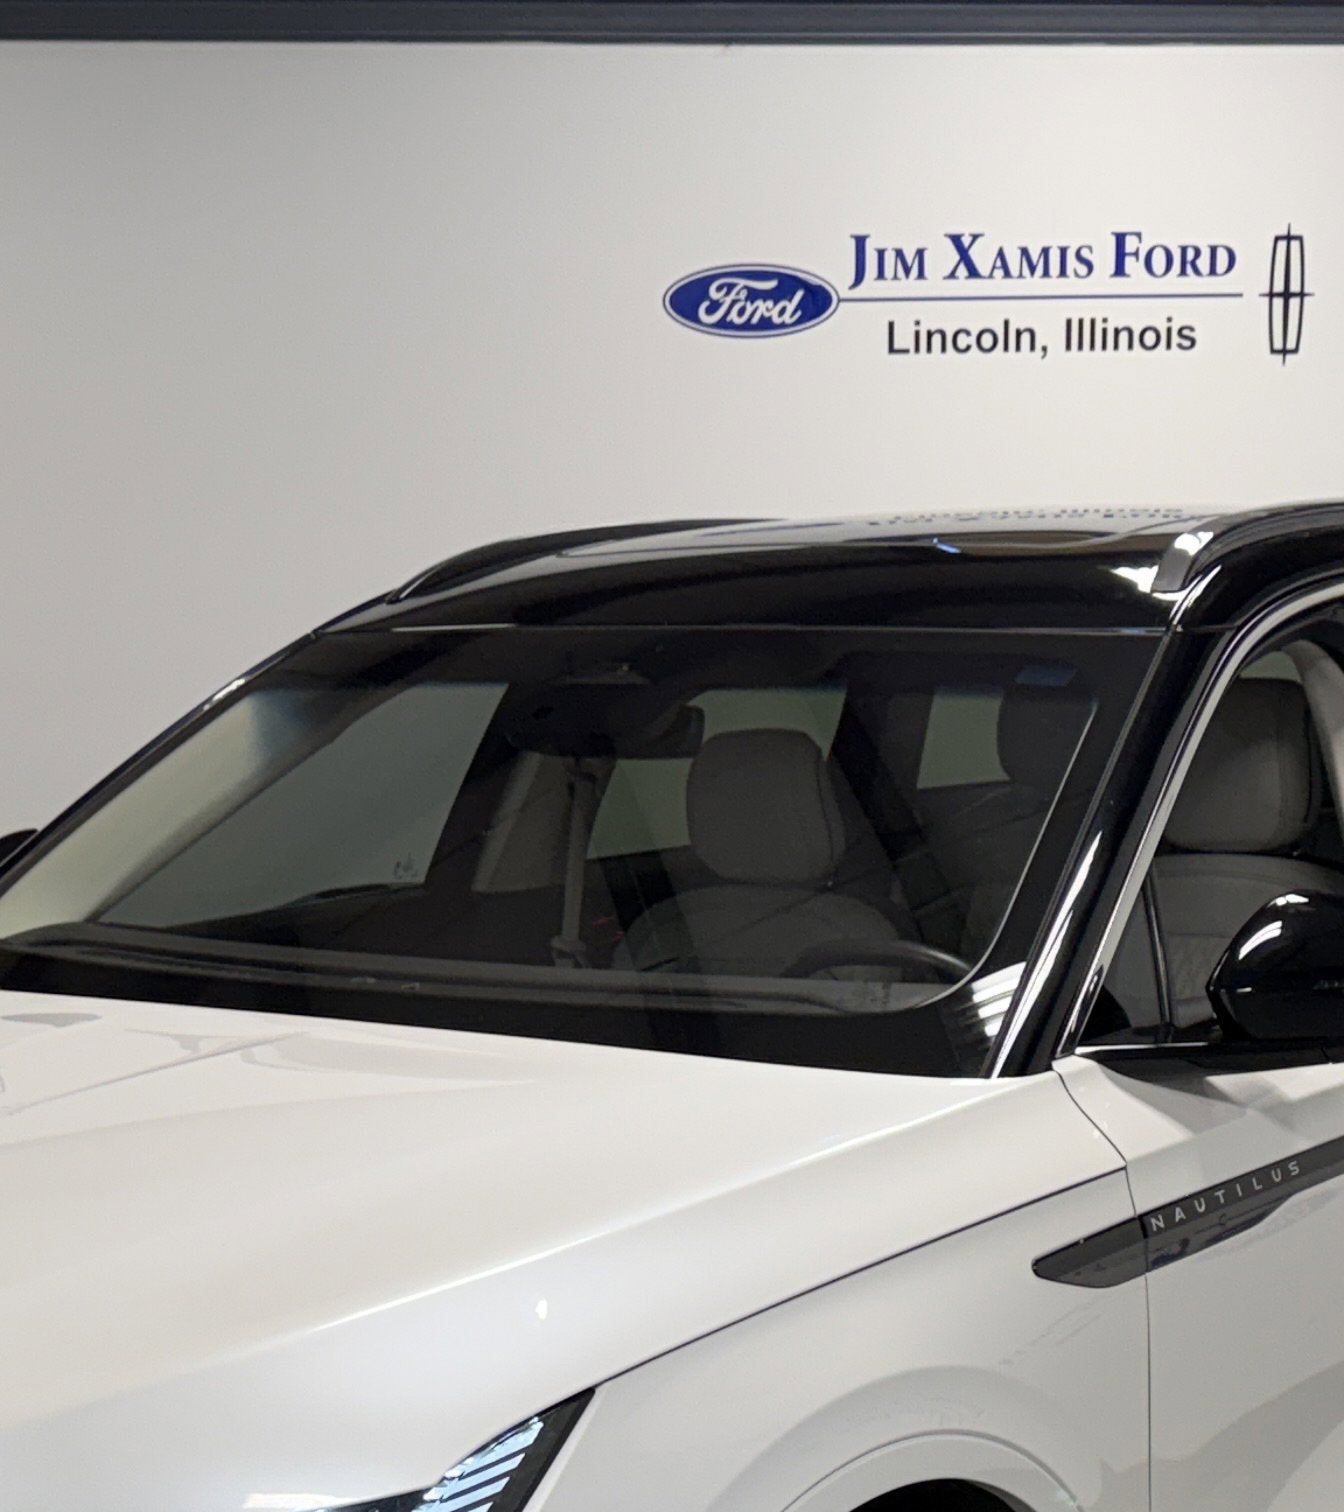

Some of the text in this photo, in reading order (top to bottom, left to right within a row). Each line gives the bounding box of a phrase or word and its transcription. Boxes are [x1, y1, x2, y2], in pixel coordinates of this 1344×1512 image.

[848, 231, 1237, 291] JIM XAMIS FORD
[697, 276, 803, 326] Ford
[887, 316, 1197, 359] Lincoln, Illinois
[1150, 1160, 1301, 1231] NAUTILUS
